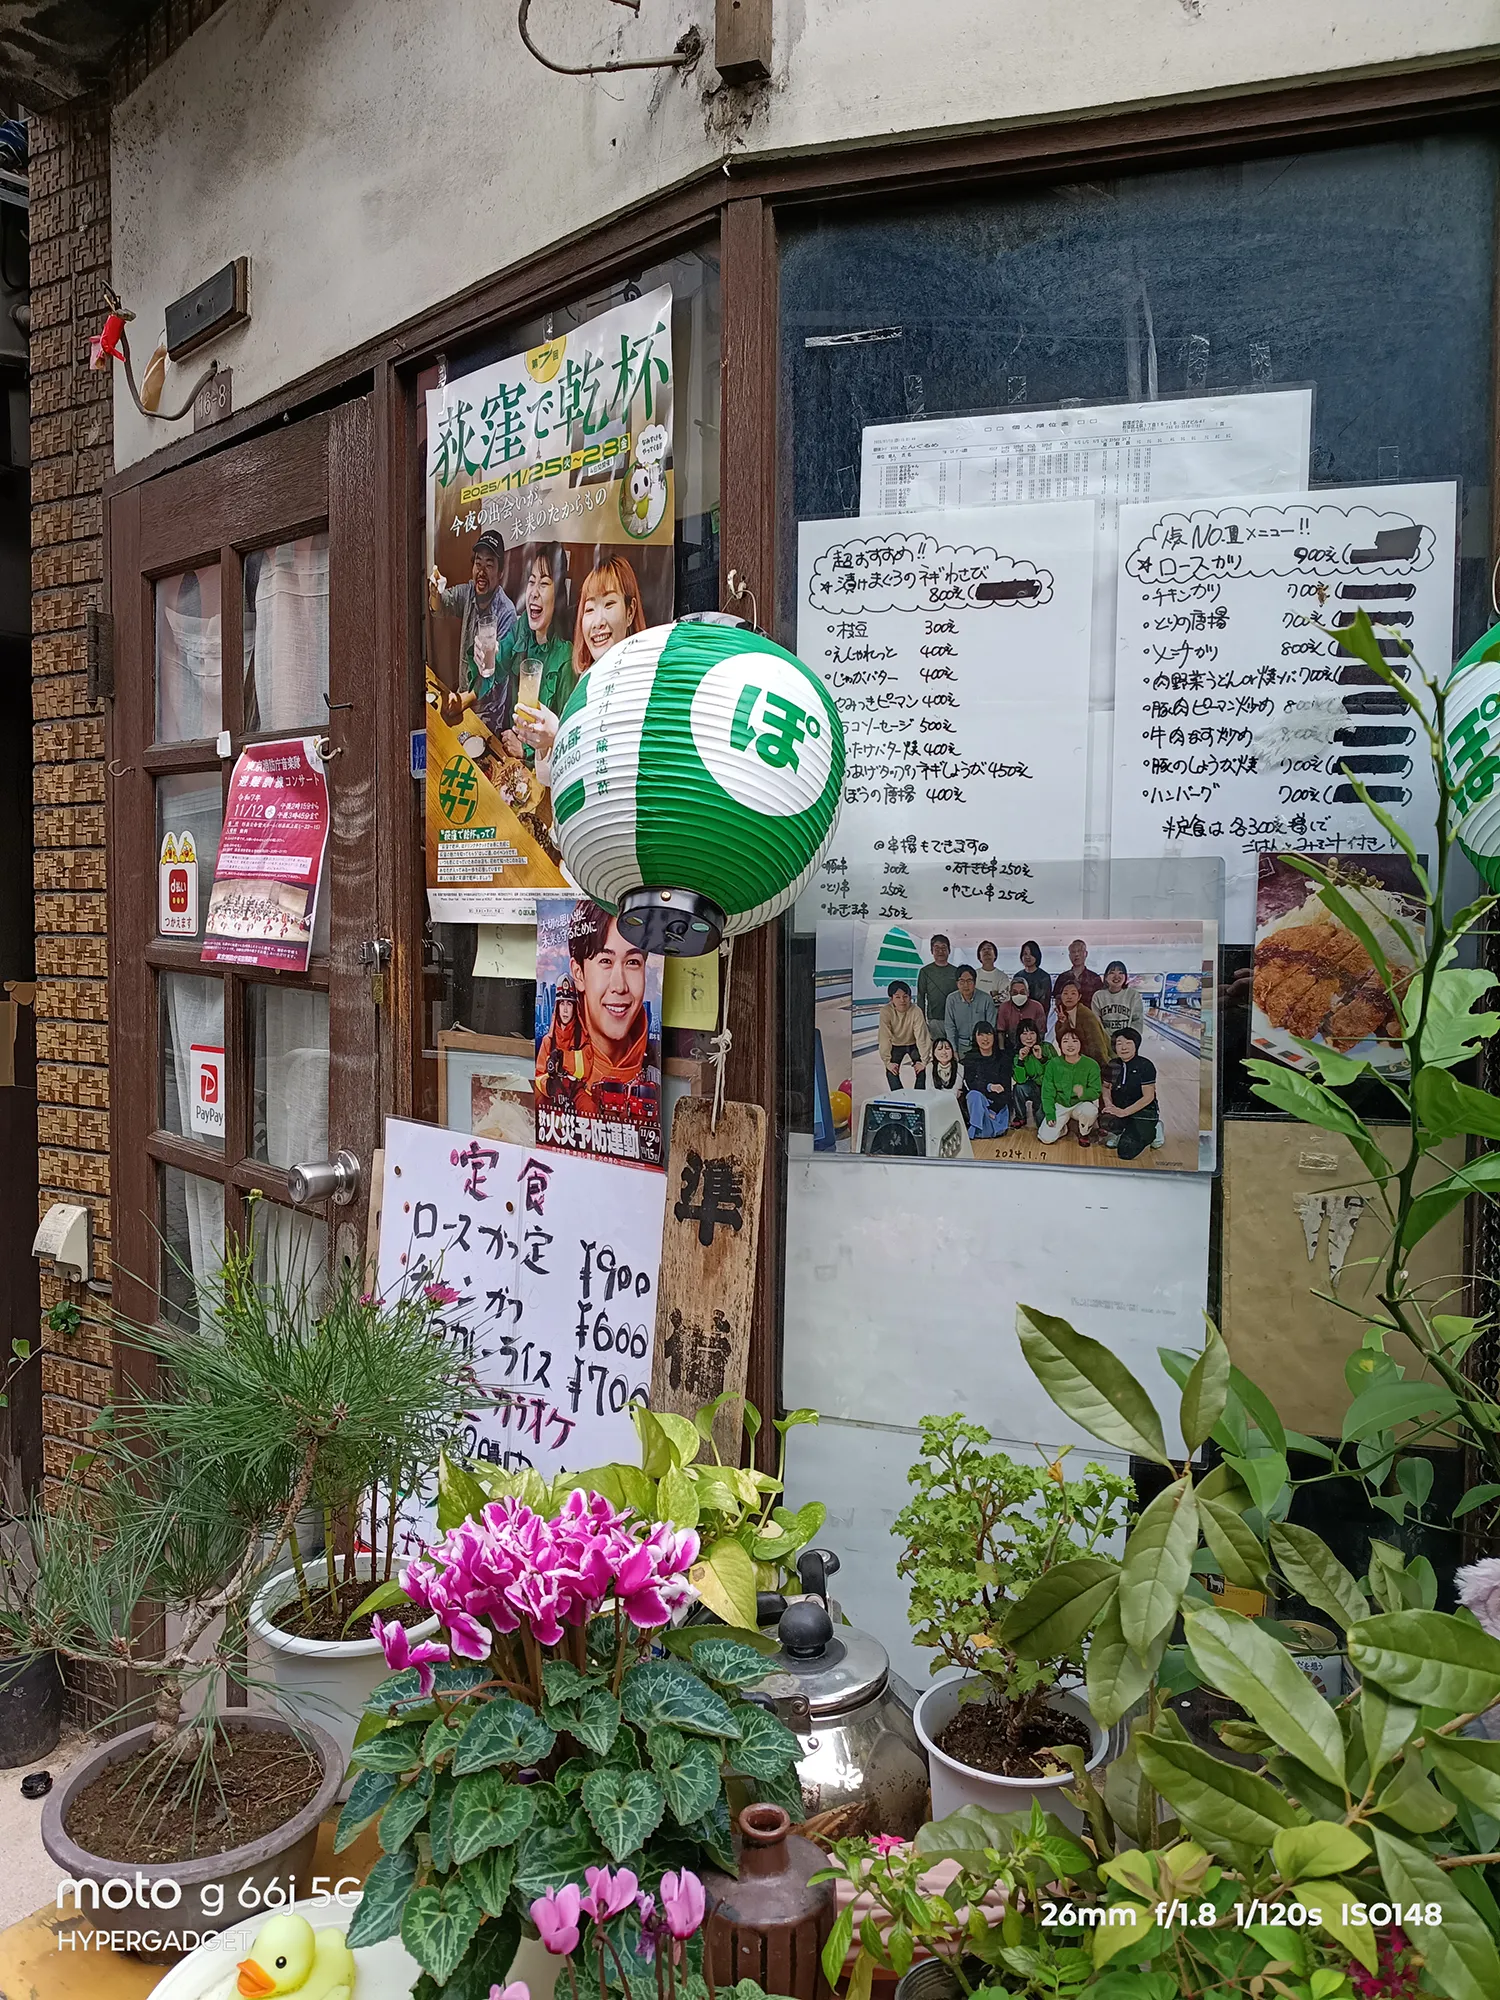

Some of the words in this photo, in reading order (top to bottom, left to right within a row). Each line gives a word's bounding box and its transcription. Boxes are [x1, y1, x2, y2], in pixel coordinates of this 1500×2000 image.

[428, 321, 669, 487] 荻窪で乾杯
[509, 487, 608, 542] 未来のたからもの
[1158, 555, 1242, 577] ロースカツ
[1152, 583, 1221, 606] チキンカツ
[836, 621, 869, 639] 枝豆
[1155, 606, 1230, 632] とりの唐揚
[1151, 696, 1275, 718] 豚肉ピーマン炒め
[729, 683, 821, 775] ぽ
[842, 718, 915, 736] ラコソーセージ
[1150, 725, 1254, 749] 牛肉なす炒め
[845, 740, 921, 760] いたけバター焼
[1151, 755, 1259, 776] 豚のしょうが焼
[844, 783, 917, 805] ぼうの唐揚
[1150, 783, 1221, 805] ハンバーグ
[234, 803, 264, 818] 11/12
[165, 916, 192, 930] つかえます
[541, 920, 598, 949] 未来を守るために
[196, 1105, 224, 1127] PayPay
[546, 1110, 640, 1159] 火災予防運動
[450, 1140, 554, 1216] 定食
[579, 1239, 651, 1301] ¥900
[575, 1300, 648, 1360] ¥600
